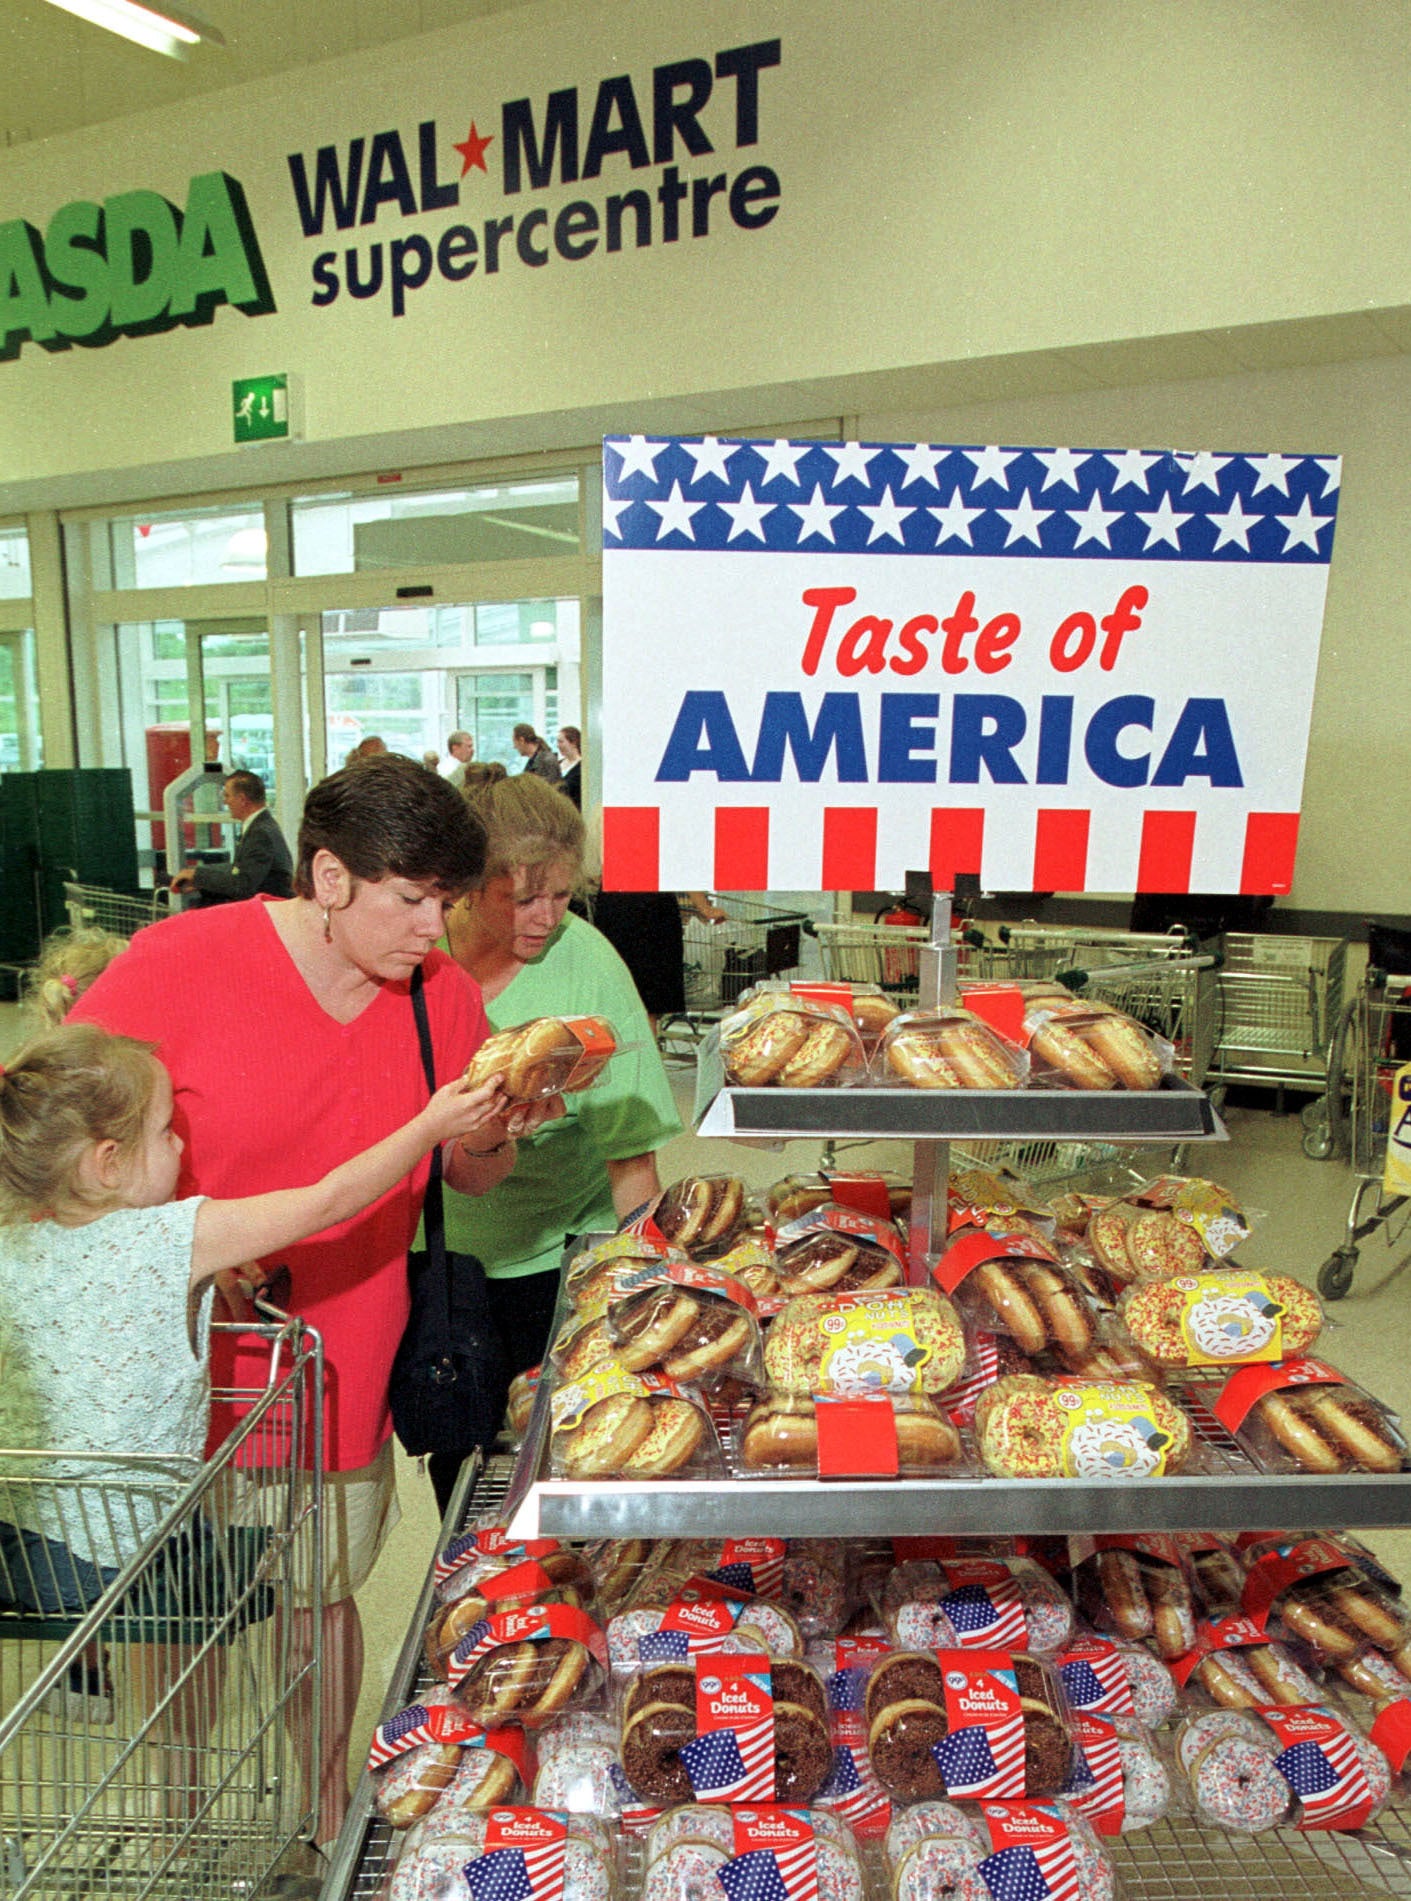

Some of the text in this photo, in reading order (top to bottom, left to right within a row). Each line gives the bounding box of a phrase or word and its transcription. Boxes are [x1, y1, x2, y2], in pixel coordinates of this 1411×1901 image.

[287, 39, 782, 238] WAL MART
[311, 164, 782, 317] supercentre
[0, 170, 277, 362] ASDA
[801, 584, 1148, 677] Taste of
[654, 690, 1244, 788] AMERICA
[864, 1310, 909, 1320] NUTS
[1099, 1393, 1146, 1402] NUTS
[691, 1604, 716, 1617] Iced
[678, 1607, 721, 1629] Donuts
[730, 1682, 738, 1692] 4
[976, 1679, 984, 1689] 4
[721, 1692, 748, 1703] Iced
[968, 1688, 995, 1701] Iced
[710, 1701, 761, 1714] Donuts
[958, 1698, 1009, 1711] Donuts
[513, 1821, 540, 1829] Iced
[758, 1821, 785, 1829] Iced
[1011, 1816, 1039, 1825] Iced
[500, 1827, 553, 1837] Donuts
[747, 1827, 800, 1837] Donuts
[1001, 1823, 1055, 1833] Donuts
